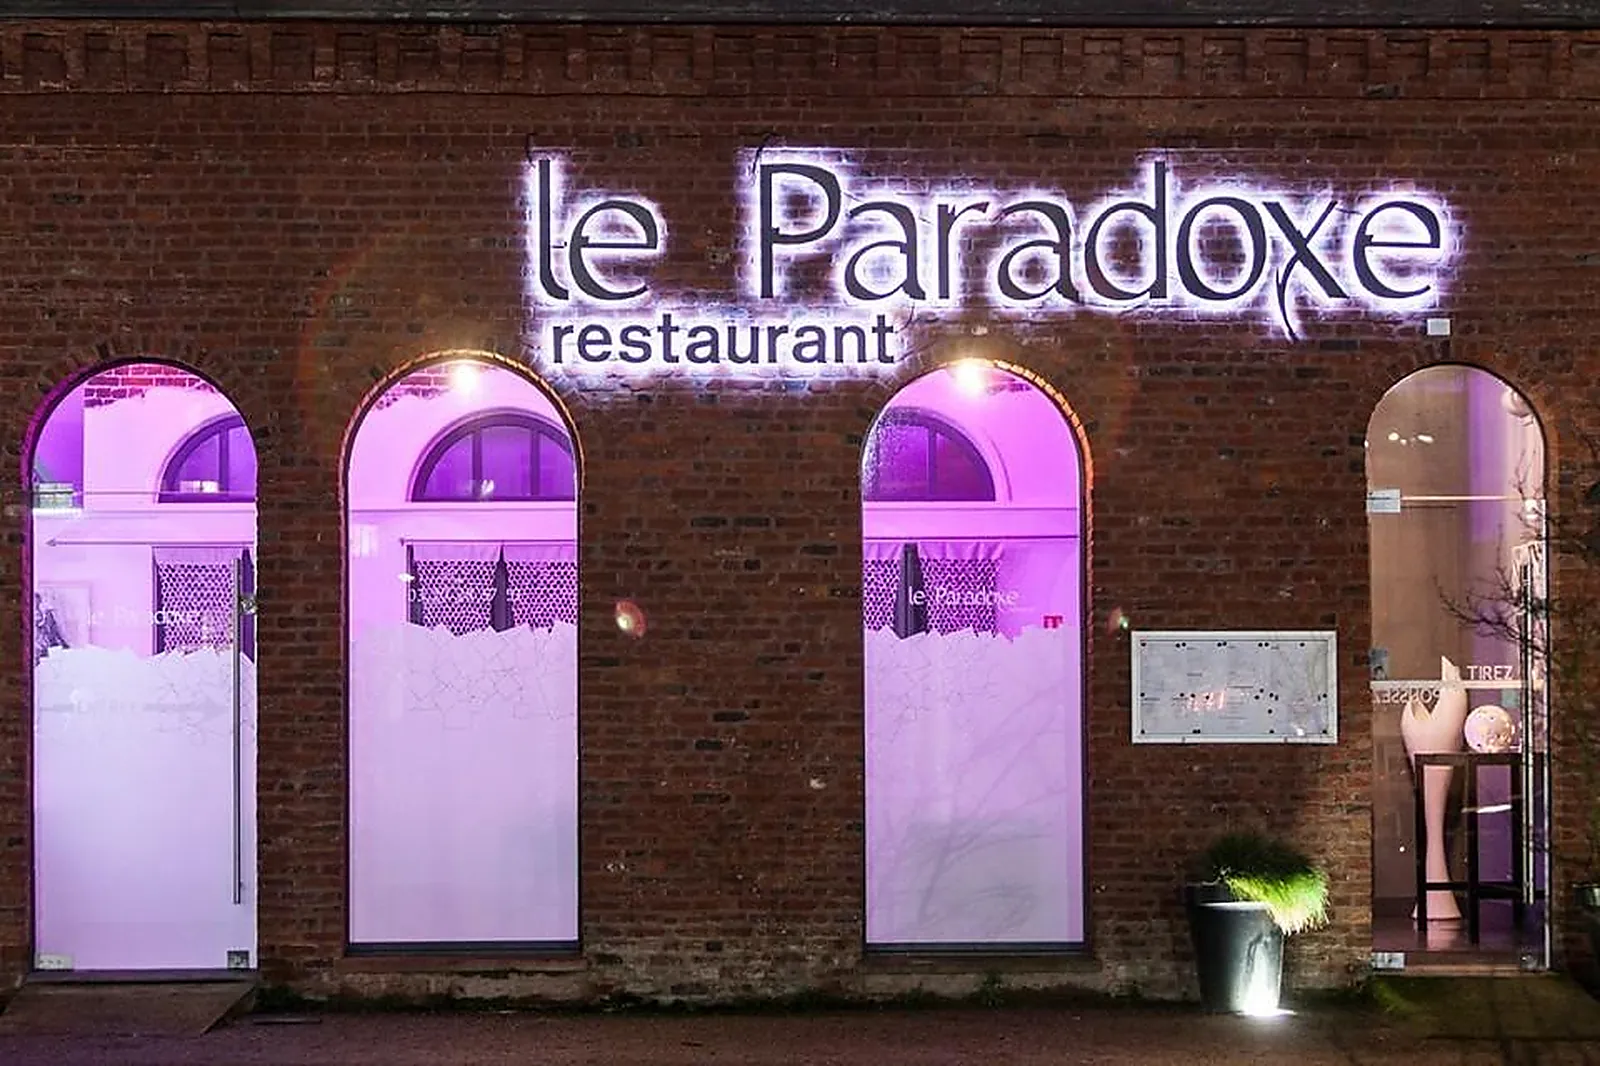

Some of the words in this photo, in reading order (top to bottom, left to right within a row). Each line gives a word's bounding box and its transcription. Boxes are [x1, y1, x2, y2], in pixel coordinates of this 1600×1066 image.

[538, 159, 659, 300] le
[758, 161, 1441, 343] Paradoxe
[552, 313, 895, 364] restaurant
[908, 585, 926, 606] le
[935, 585, 1020, 612] Paradoxe
[1466, 665, 1514, 681] TIREZ
